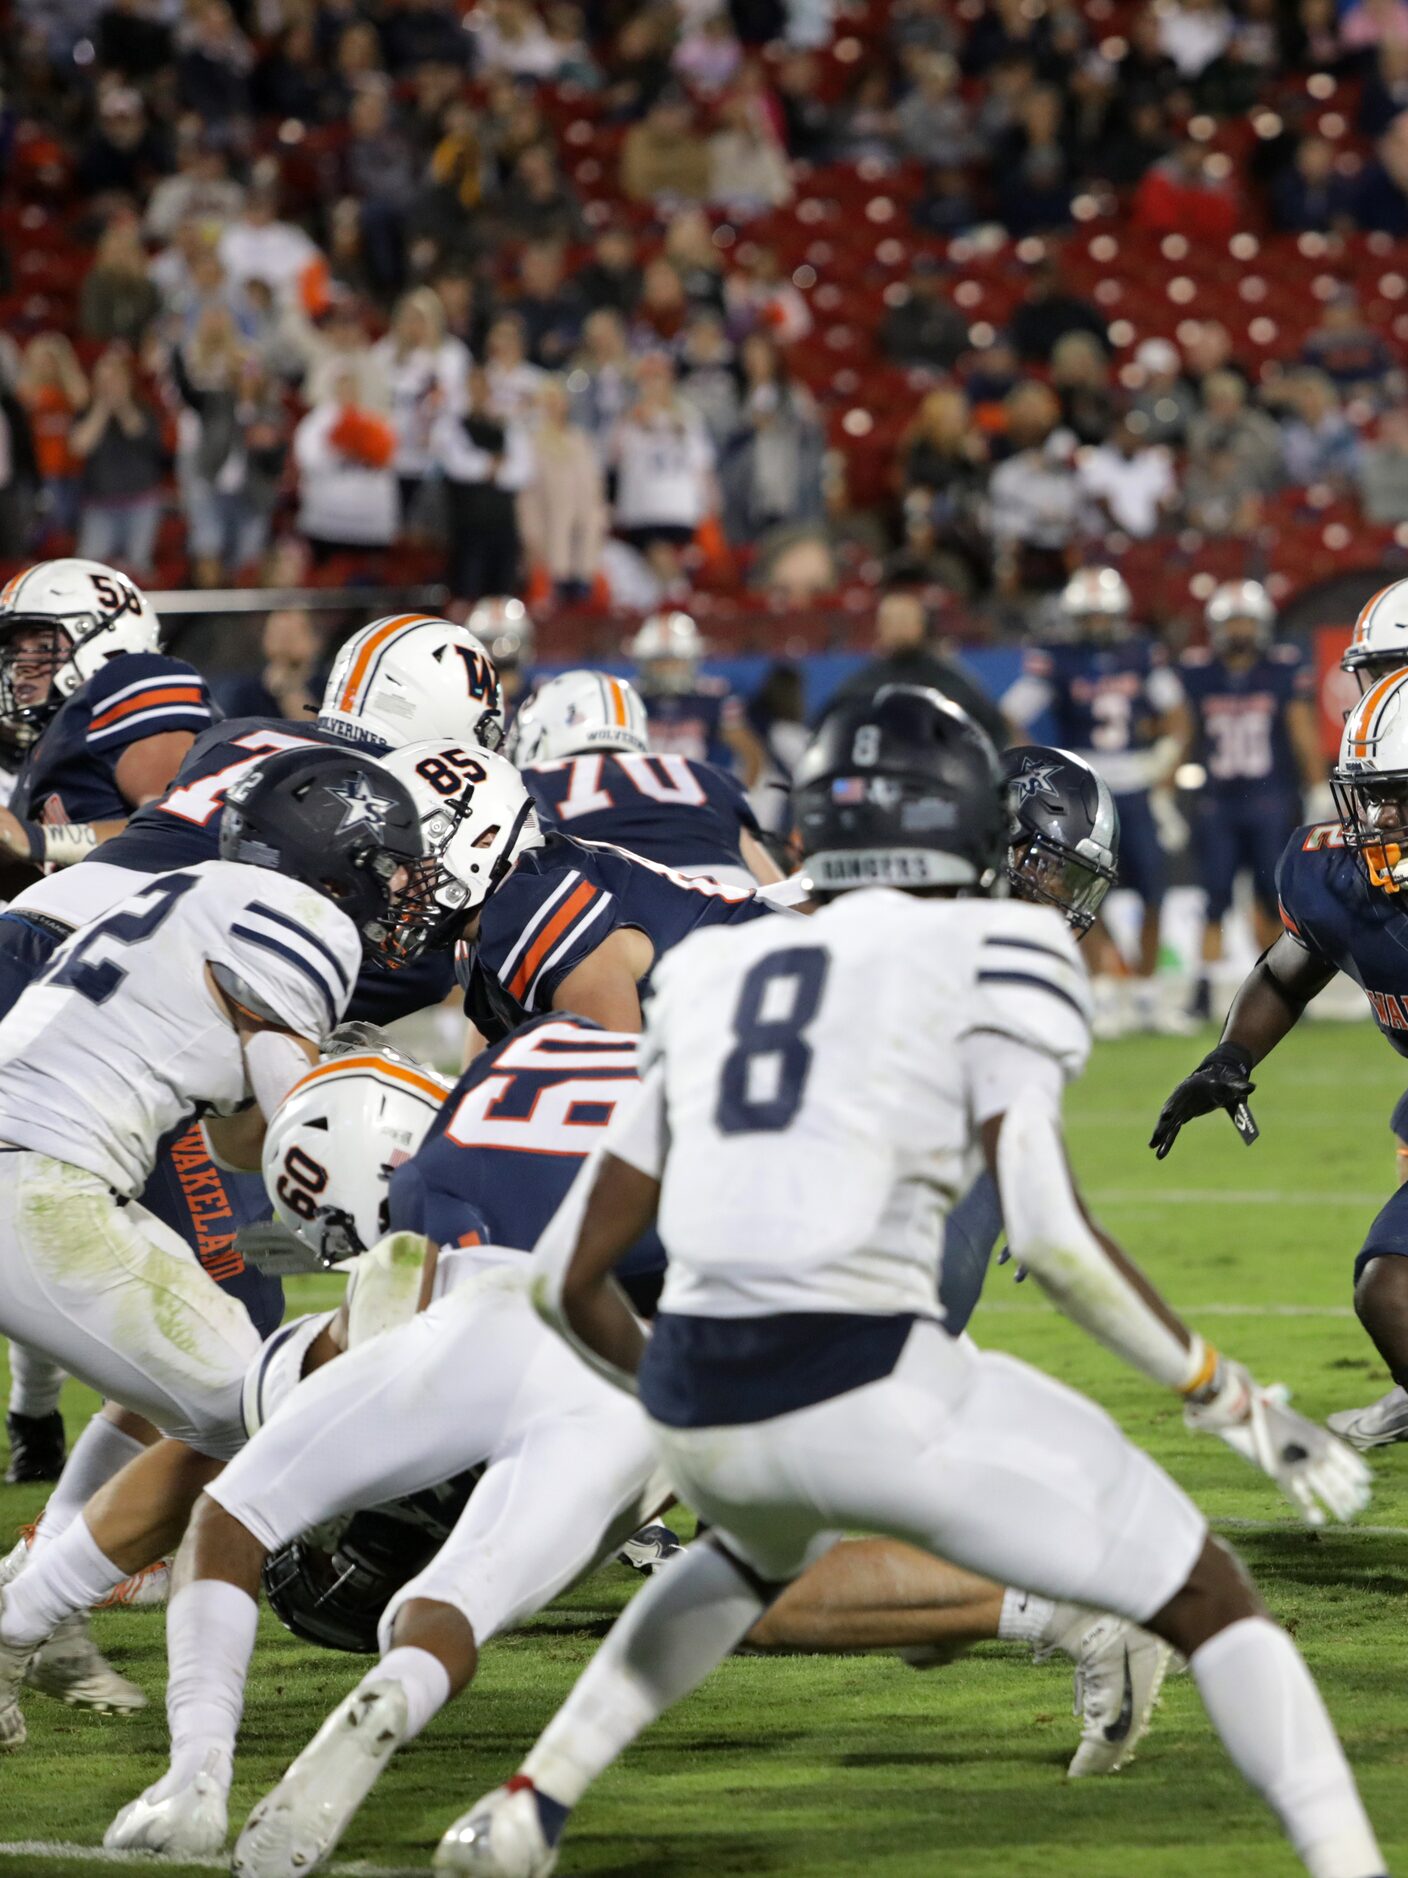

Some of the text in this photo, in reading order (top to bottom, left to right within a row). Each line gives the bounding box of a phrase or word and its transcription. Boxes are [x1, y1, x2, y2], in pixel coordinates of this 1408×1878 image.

[453, 643, 499, 710] W
[415, 748, 487, 796] 85
[853, 724, 881, 767] 8
[533, 752, 708, 820] 70
[28, 872, 203, 1006] 2
[714, 943, 834, 1139] 8
[444, 1021, 645, 1157] 60
[276, 1146, 328, 1221] 60
